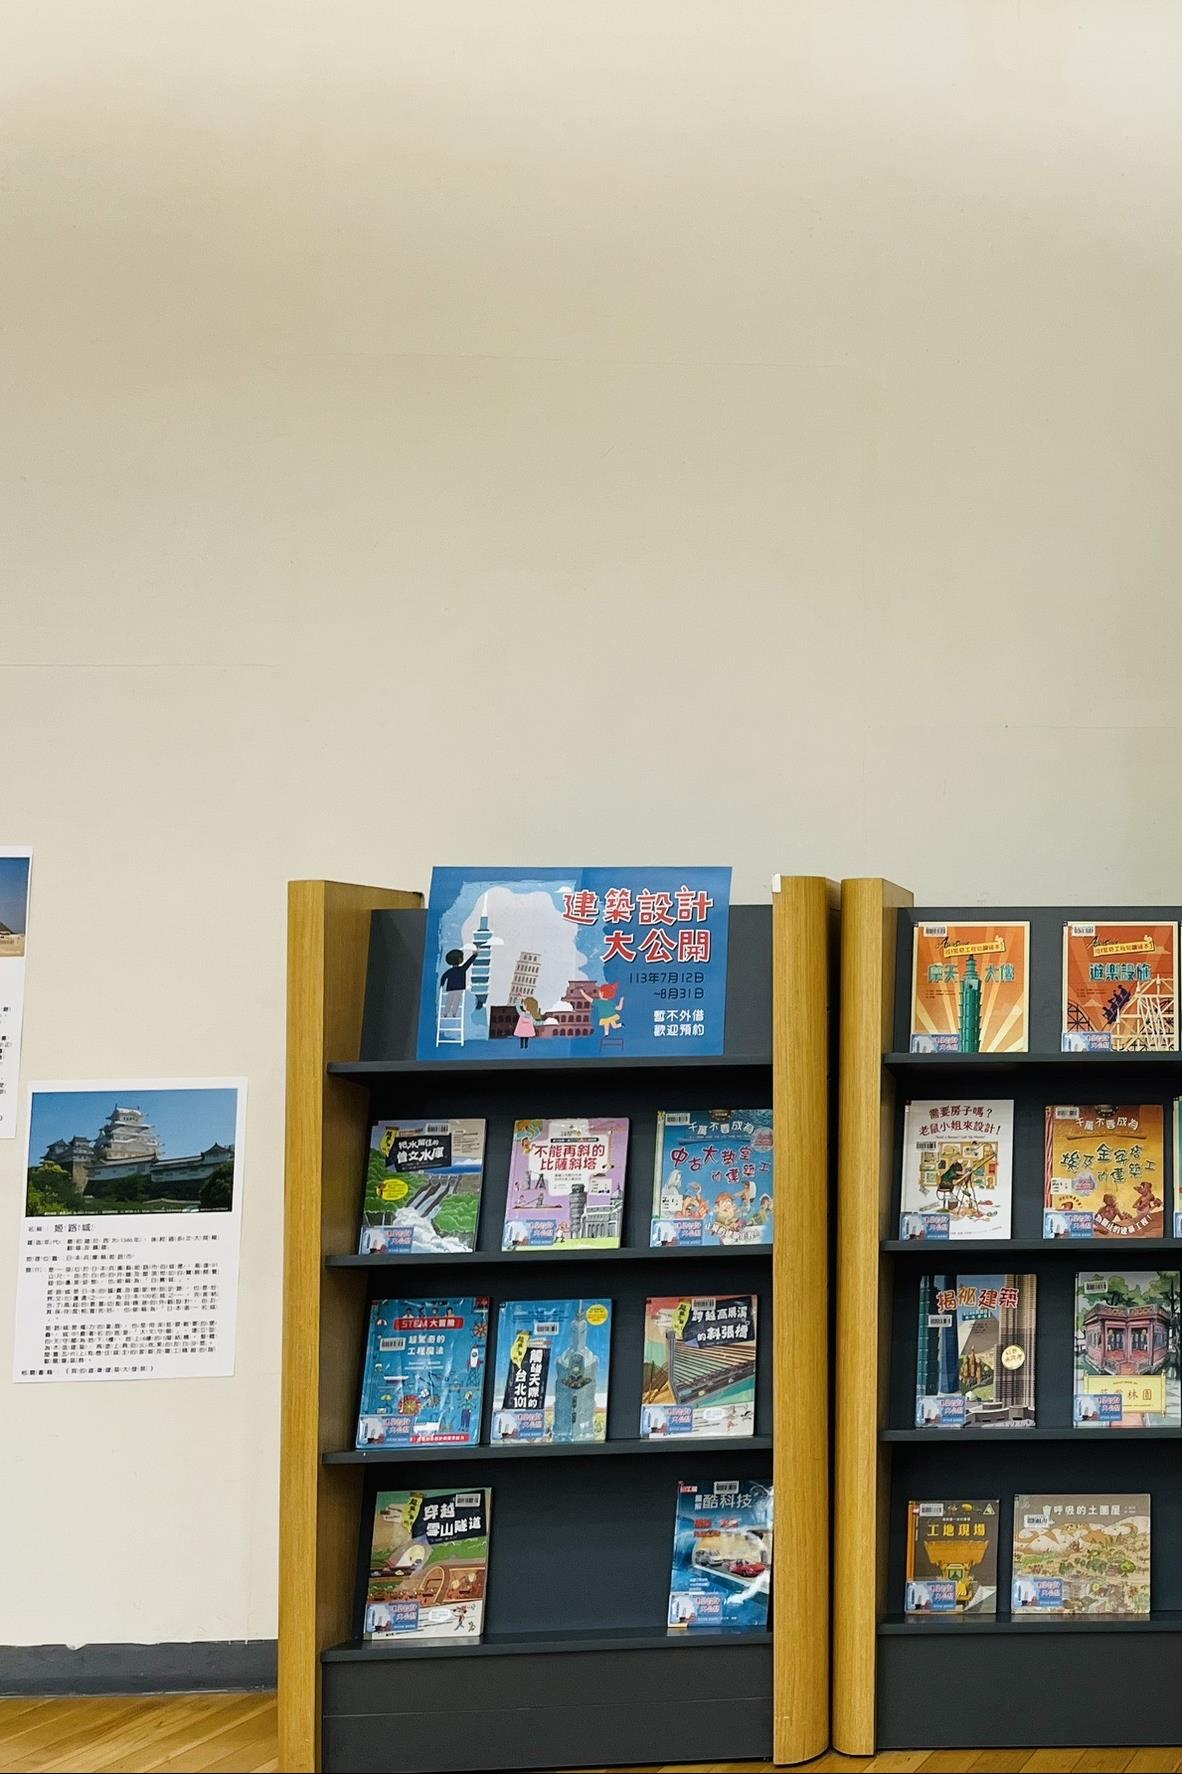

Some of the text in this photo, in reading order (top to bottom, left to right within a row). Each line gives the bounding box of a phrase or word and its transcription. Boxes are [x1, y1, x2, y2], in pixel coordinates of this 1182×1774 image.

[562, 884, 714, 926] 建築設計
[600, 928, 711, 964] 大公開
[628, 972, 705, 985] 113年7月12日
[653, 987, 705, 1000] ~8月31日
[653, 1008, 705, 1023] 暫不外借
[653, 1024, 705, 1037] 歡迎預約
[928, 1104, 993, 1119] 需要房子嗎？
[534, 1143, 606, 1157] 不能再斜的
[513, 1369, 528, 1409] 台北101
[702, 1493, 753, 1509] 酷科技
[423, 1502, 456, 1521] 穿越
[426, 1516, 482, 1537] 雪山隧道
[927, 1523, 987, 1537] 工地現場
